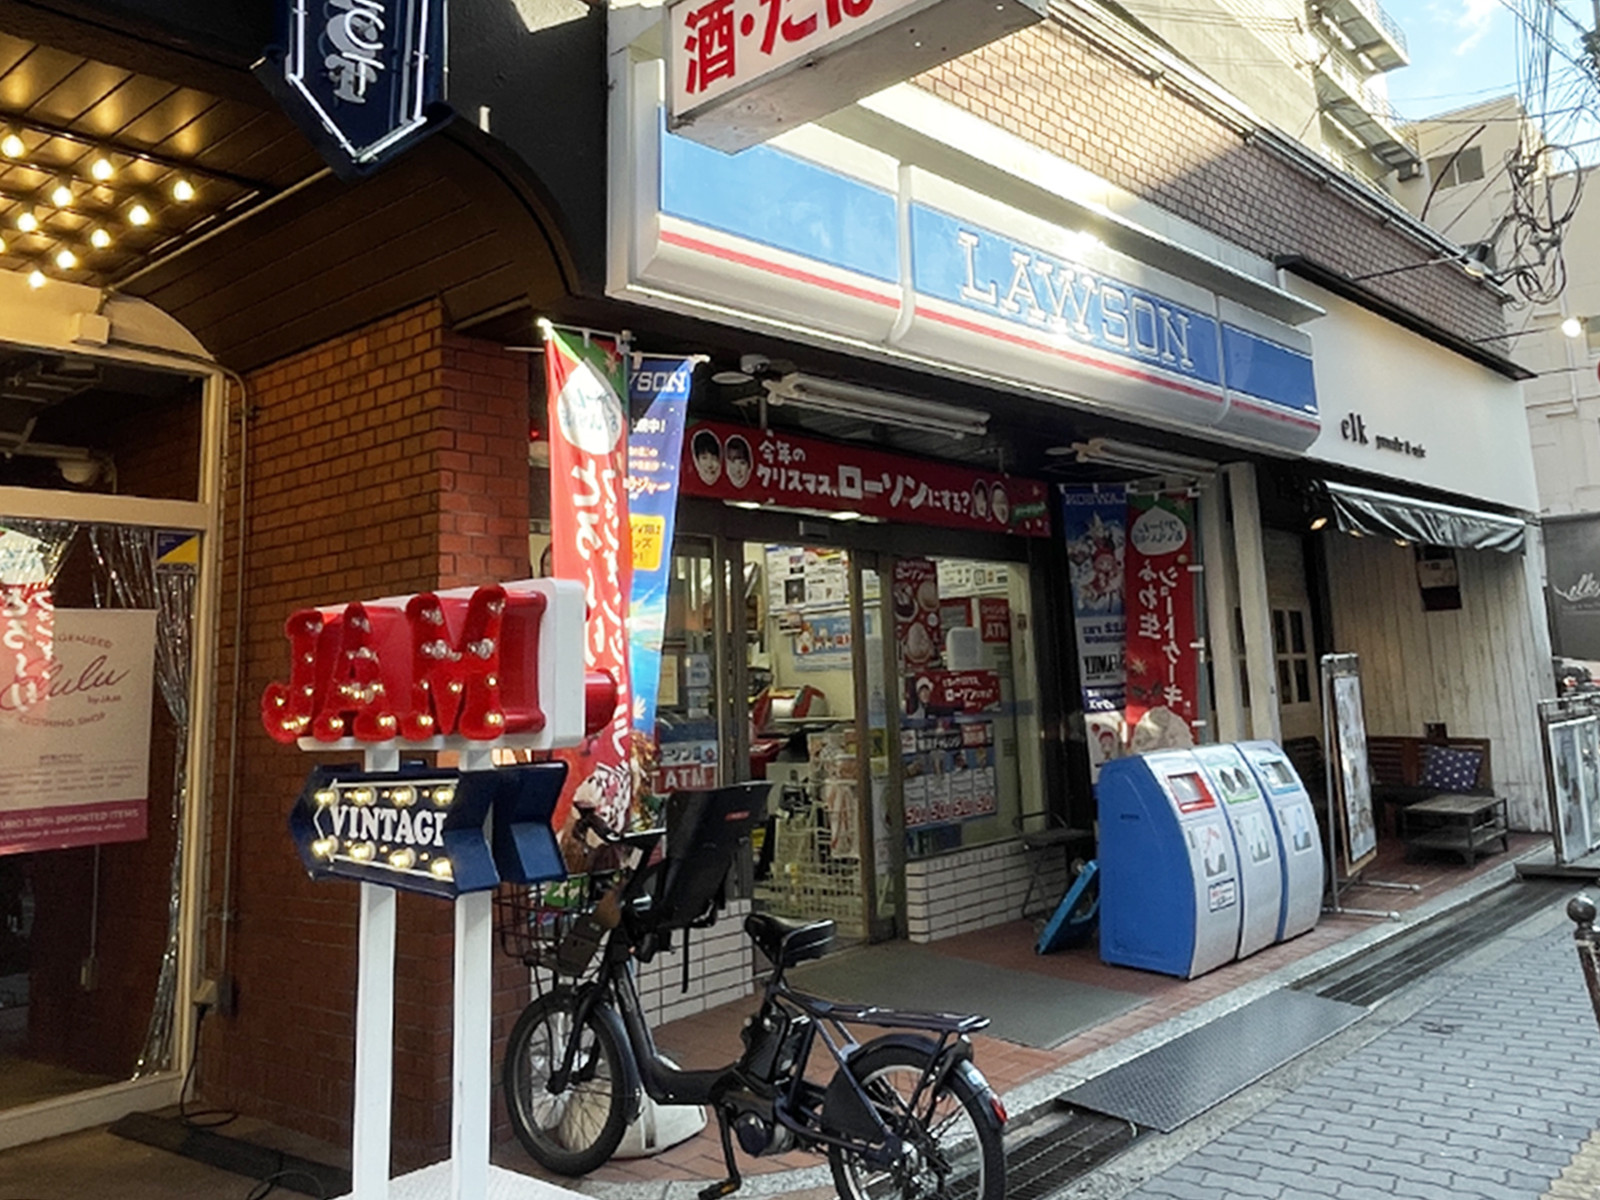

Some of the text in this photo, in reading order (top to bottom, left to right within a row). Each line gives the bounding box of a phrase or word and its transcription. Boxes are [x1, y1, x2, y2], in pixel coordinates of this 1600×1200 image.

[957, 228, 1195, 371] LAWSON
[1341, 412, 1368, 444] elk
[759, 440, 806, 463] 今年の
[262, 584, 508, 743] JAM
[664, 767, 706, 790] ATM
